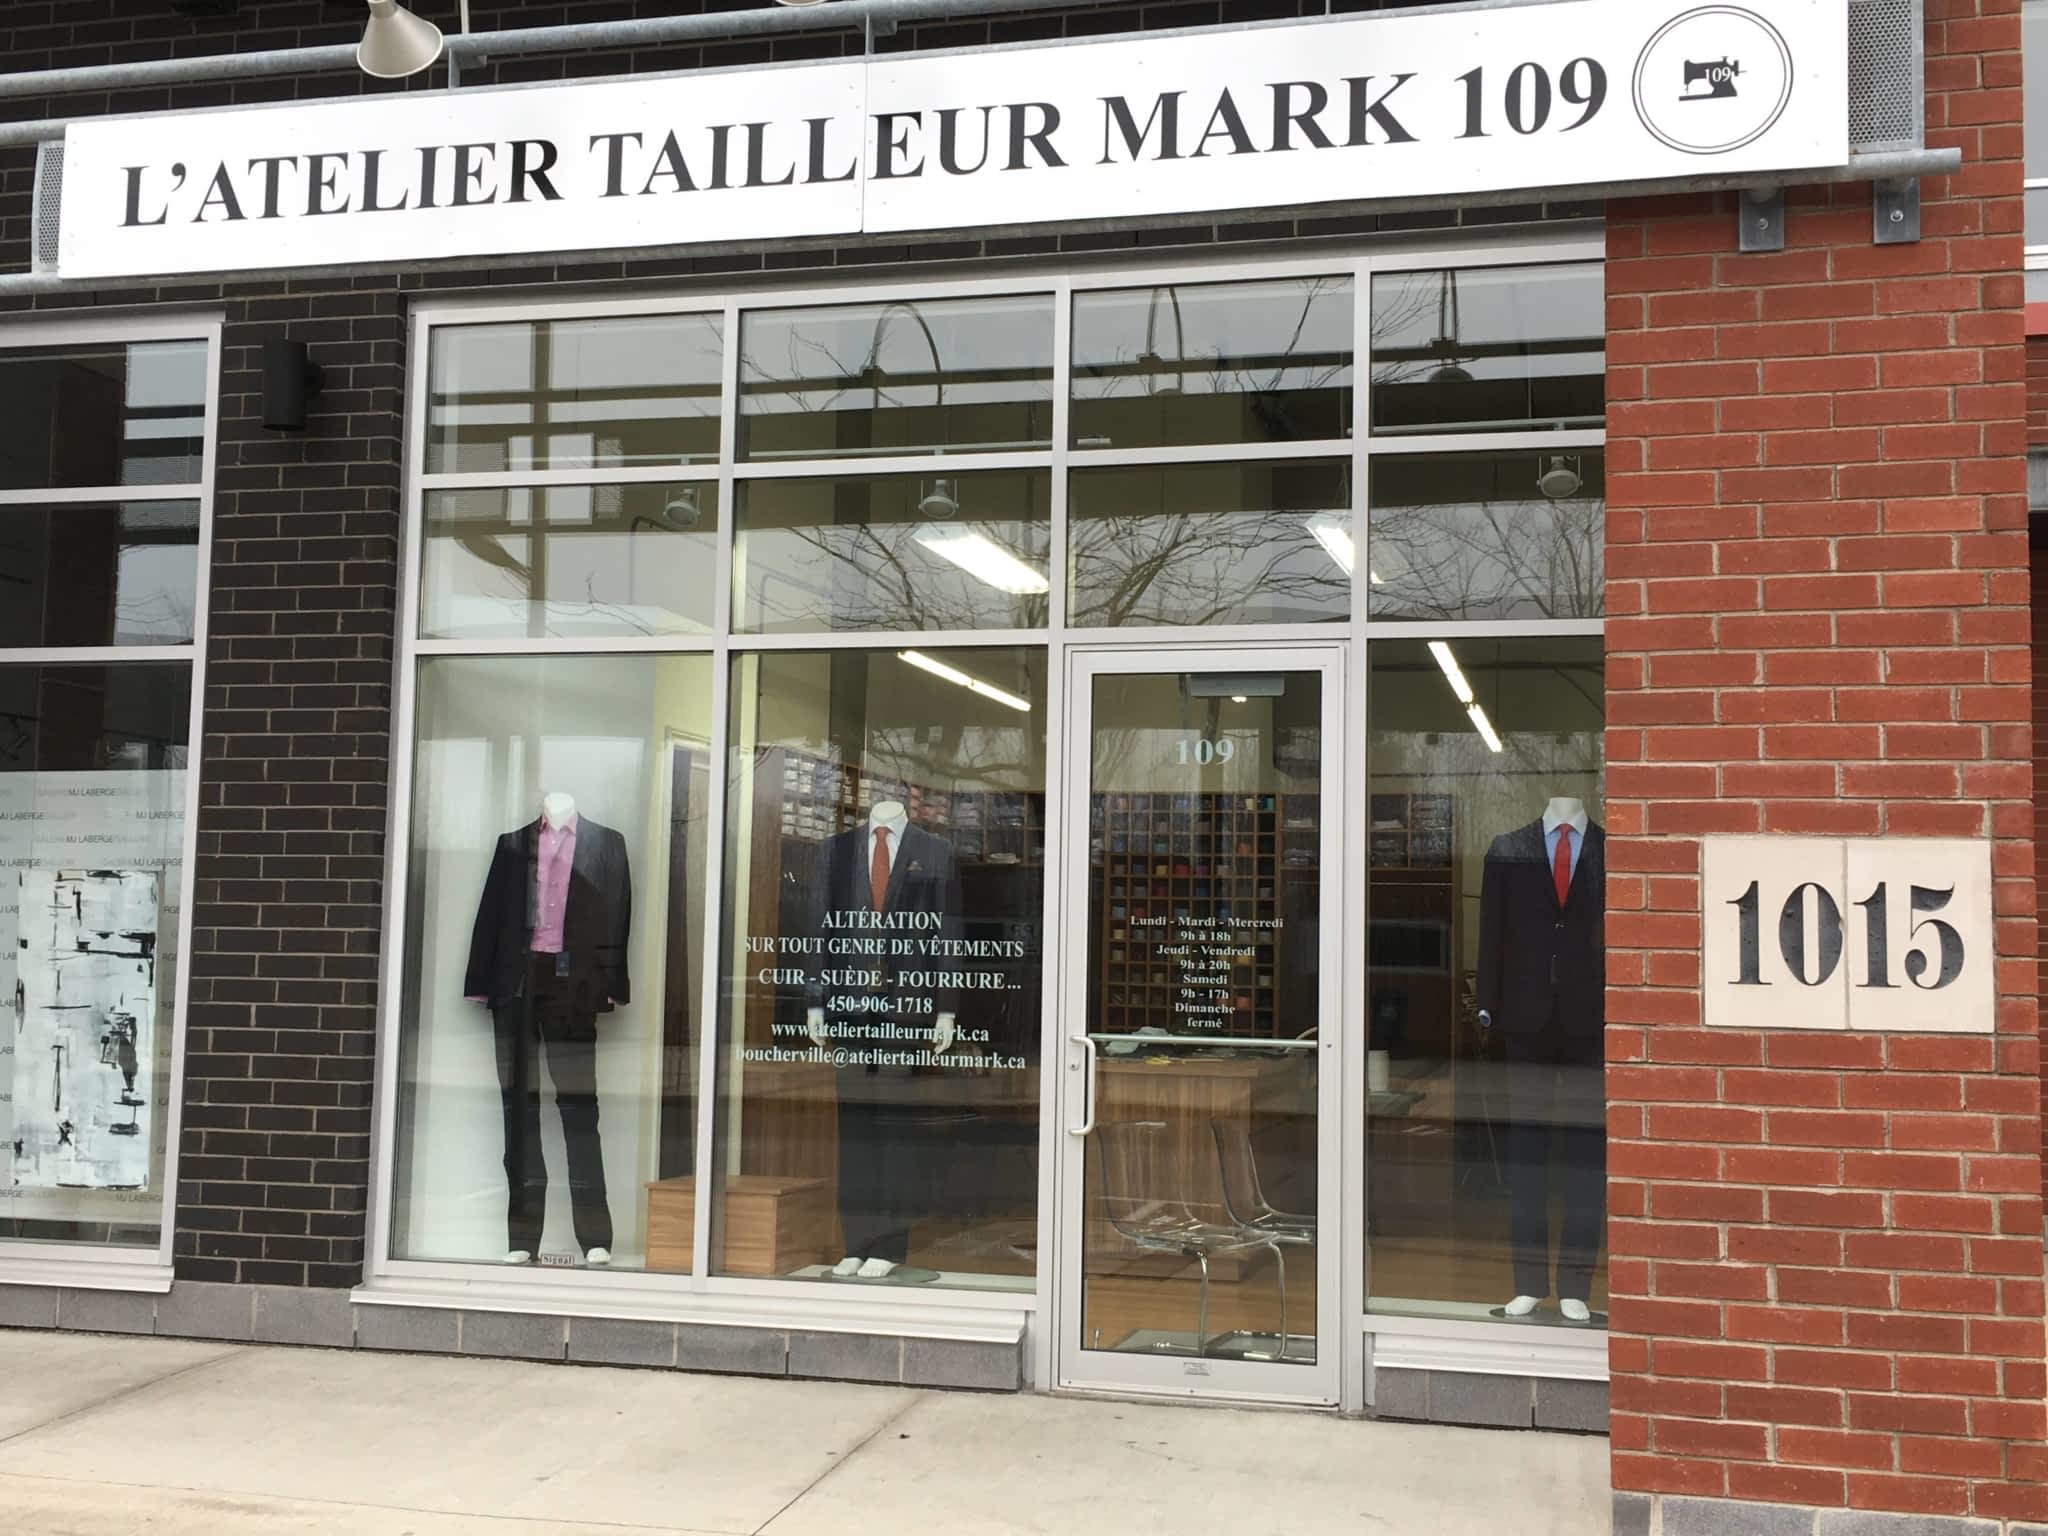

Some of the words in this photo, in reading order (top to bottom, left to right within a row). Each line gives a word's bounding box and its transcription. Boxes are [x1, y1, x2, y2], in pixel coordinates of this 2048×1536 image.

[1704, 67, 1731, 82] 109
[588, 101, 1069, 198] TAILLEUR
[1096, 72, 1420, 165] MARK
[1453, 56, 1608, 139] 109
[1176, 739, 1234, 765] 109
[82, 788, 117, 797] LABERGE
[821, 906, 943, 930] ALTÉRATION
[1130, 915, 1167, 926] Lundi
[1178, 915, 1216, 927] Mardi
[1227, 916, 1283, 928] Mercredi
[1180, 930, 1195, 941] 9h
[1199, 931, 1206, 941] à
[1209, 930, 1231, 942] 18h
[744, 936, 775, 953] SUR
[778, 937, 825, 954] TOUT
[828, 938, 885, 956] GENRE
[891, 939, 914, 956] DE
[918, 935, 1024, 957] VÊTEMENTS
[1156, 944, 1190, 956] Jeudi
[1200, 945, 1255, 957] Vendredi
[1180, 959, 1195, 970] 9h
[1199, 959, 1206, 970] à
[1209, 959, 1231, 970] 20h
[758, 968, 806, 985] CUIR
[820, 965, 882, 987] SUÈDE
[1183, 973, 1228, 985] Samedi
[1180, 988, 1195, 999] 9h
[1207, 988, 1229, 1000] 17h
[826, 996, 933, 1014] 450-906-1718
[1175, 1002, 1236, 1014] Dimanche
[1186, 1016, 1222, 1029] fermé
[771, 1022, 990, 1042] wwwateliertailleurmark.ca
